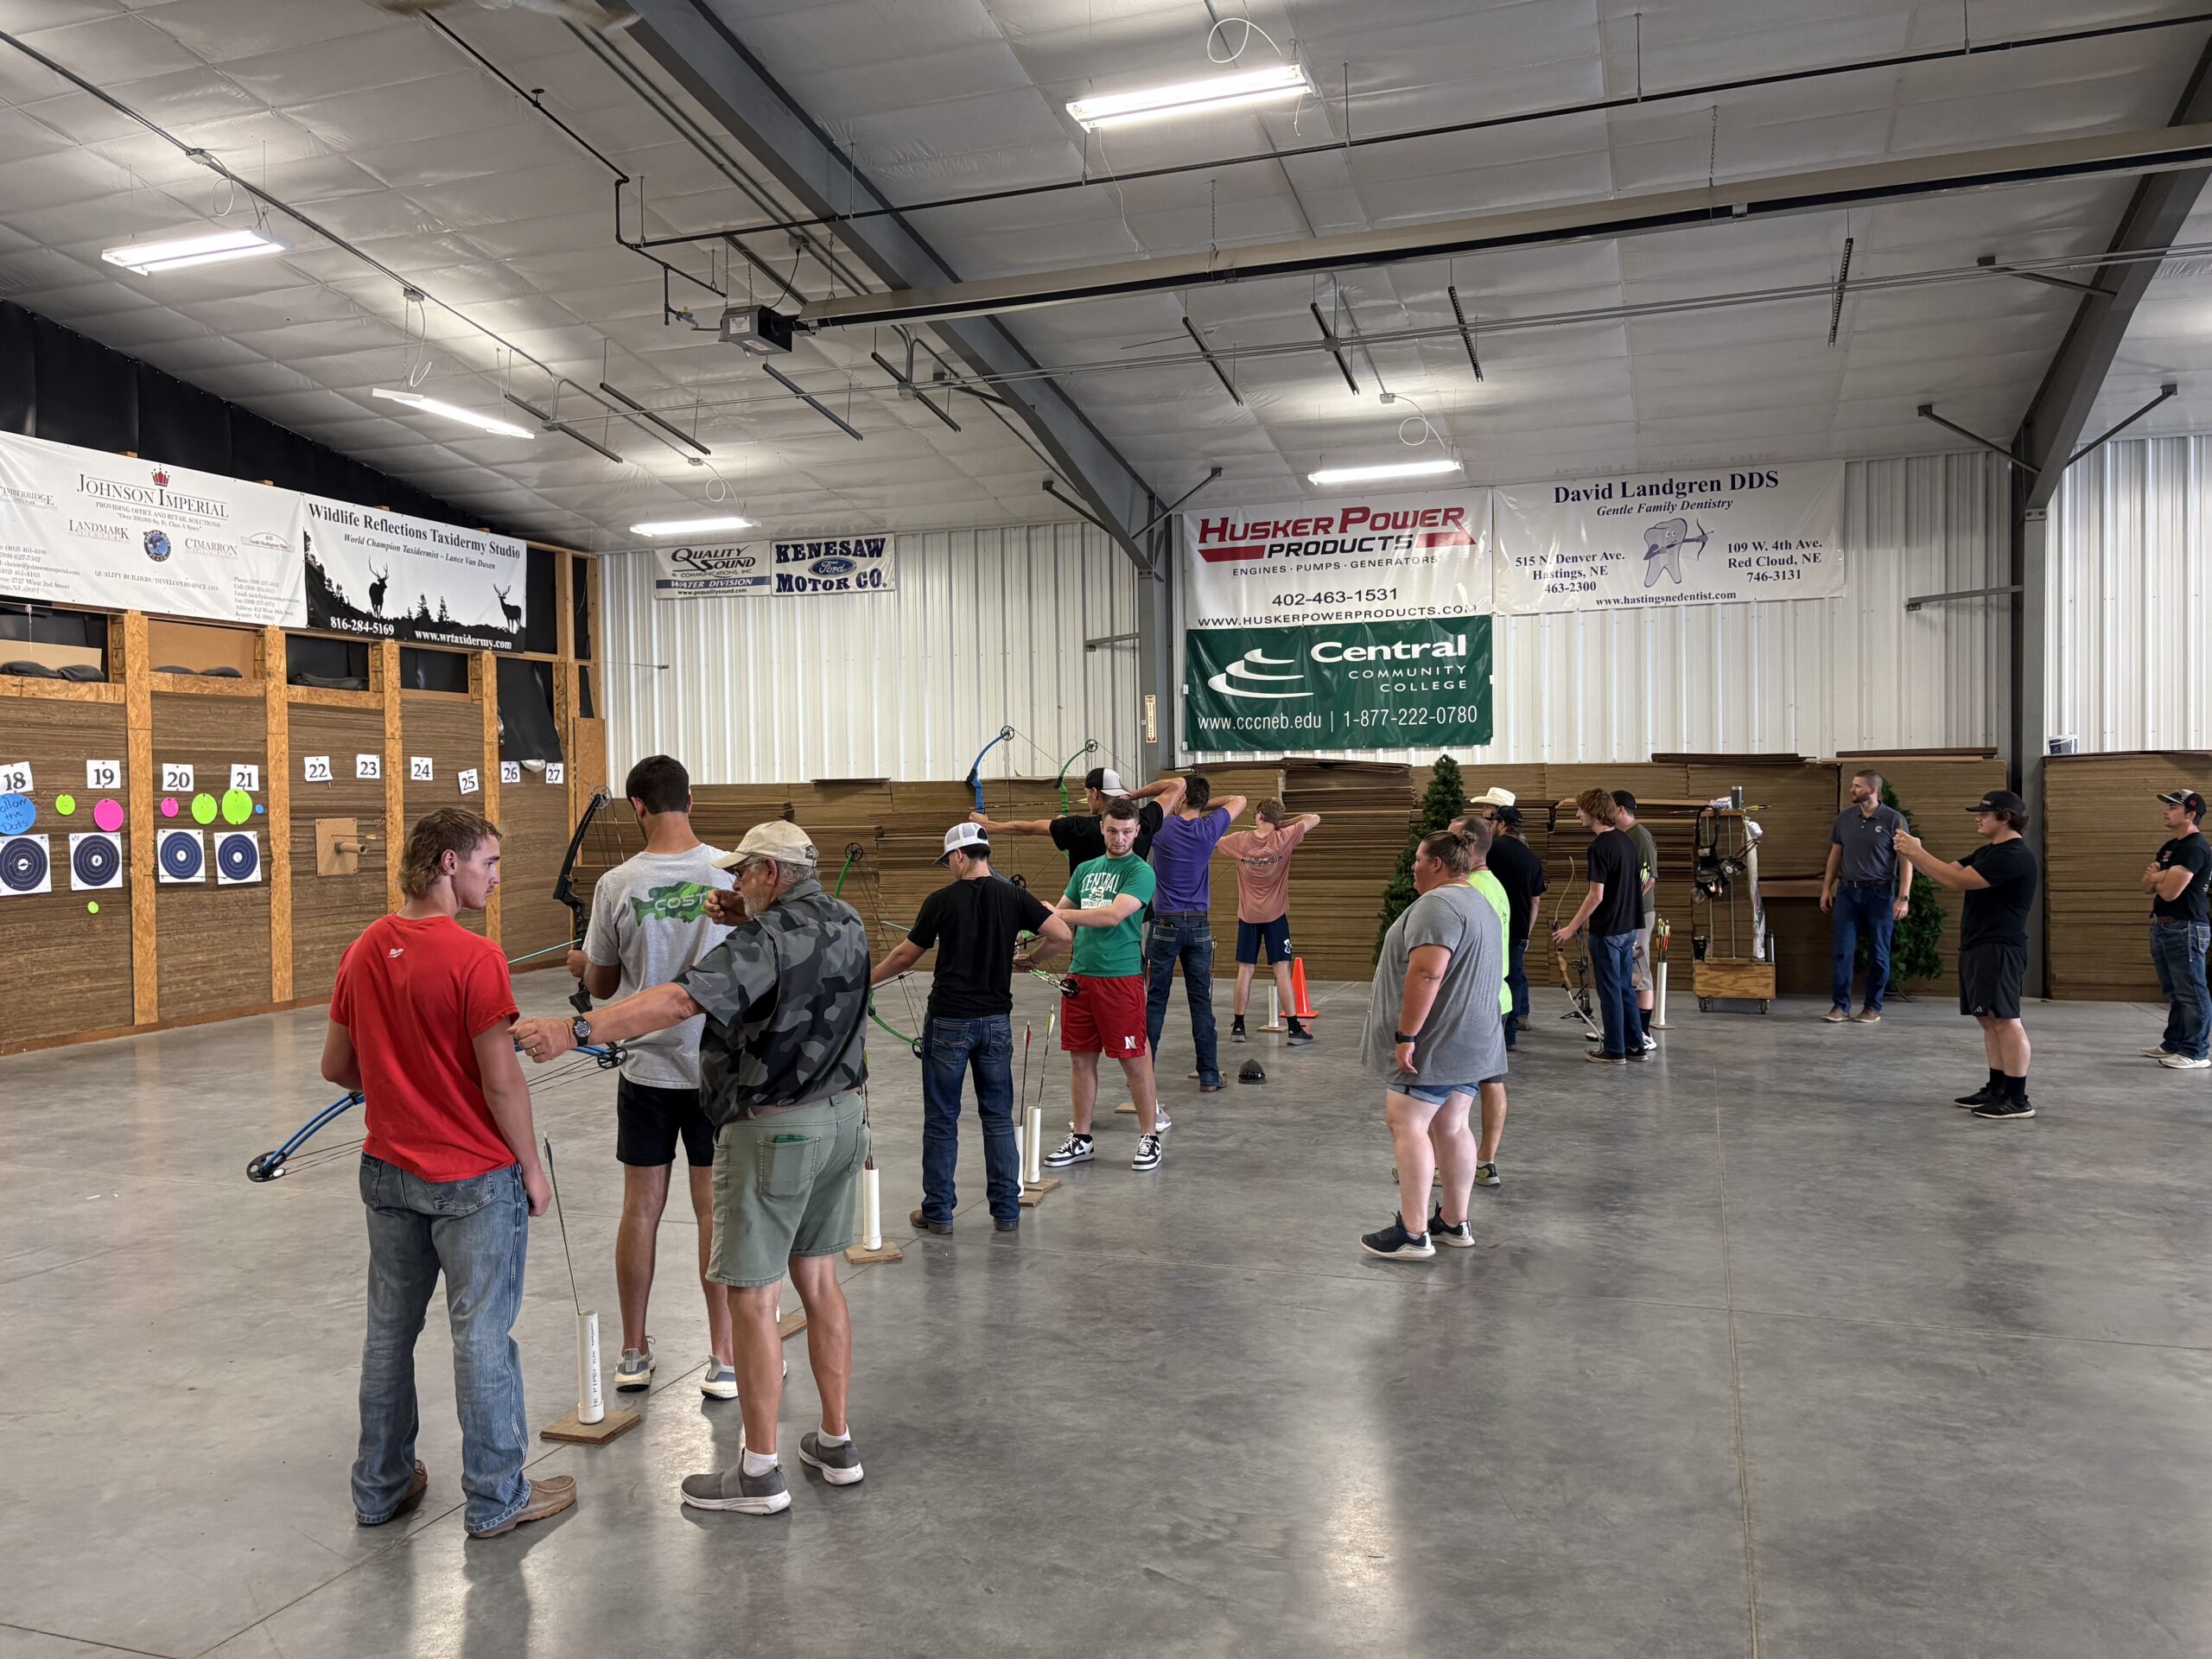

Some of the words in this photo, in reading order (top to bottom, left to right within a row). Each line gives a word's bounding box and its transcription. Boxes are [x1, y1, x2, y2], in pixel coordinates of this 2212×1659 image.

[77, 474, 155, 505] JOHNSON
[159, 489, 229, 518] IMPERIAL
[1554, 483, 1613, 504] David
[1620, 477, 1721, 501] Landgren
[1729, 470, 1779, 491] DDS
[96, 501, 130, 512] PROVIDING
[131, 507, 152, 517] OFFICE
[153, 511, 166, 519] AND
[188, 518, 221, 528] SOLUTIONS
[1597, 504, 1634, 517] Gentle
[1637, 501, 1678, 516] Family
[1680, 498, 1733, 512] Dentistry
[69, 519, 129, 540] LANDMARK
[308, 503, 359, 527] Wildlife
[364, 515, 428, 541] Reflections
[430, 529, 486, 555] Taxidermy
[489, 542, 520, 559] Studio
[1198, 517, 1334, 543] HUSKER
[1338, 506, 1465, 534] POWER
[185, 537, 237, 556] CIMARRON
[344, 533, 365, 546] World
[366, 537, 401, 553] Champion
[403, 544, 439, 559] Taxidermist
[445, 553, 464, 563] Lance
[465, 556, 476, 566] Van
[477, 559, 495, 569] Dusen
[671, 544, 752, 563] QUALITY
[775, 537, 887, 564] KENESAW
[1268, 534, 1414, 558] PRODUCTS
[1728, 542, 1749, 554] 109
[1751, 541, 1768, 552] W.
[1771, 538, 1793, 551] 4th
[1795, 537, 1822, 550] Ave.
[701, 557, 756, 570] SOUND
[818, 561, 845, 574] Ford
[1233, 565, 1287, 576] ENGINES
[1296, 562, 1340, 572] PUMPS
[1351, 556, 1439, 569] GENERATORS
[1515, 556, 1536, 568] 515
[1539, 555, 1553, 566] N.
[1555, 552, 1598, 564] Denver
[1599, 550, 1625, 563] Ave.
[1727, 556, 1753, 568] Red
[1755, 554, 1798, 569] Cloud,
[1801, 552, 1821, 564] NE
[776, 575, 850, 594] MOTOR
[855, 568, 887, 588] CO.
[1532, 567, 1586, 582] Hastings,
[1589, 565, 1608, 576] NE
[1746, 569, 1802, 583] 746-3131
[671, 580, 705, 588] WATER
[709, 578, 753, 588] DIVISION
[1544, 581, 1597, 594] 463-2300
[1272, 588, 1398, 607] 402-463-1531
[1596, 590, 1737, 607] www.hastingsnedentist.com
[1198, 604, 1477, 627] WWW.HUSKERPOWERPRODUCTS.COM
[330, 616, 395, 636] 816-284-5169
[415, 631, 512, 650] www.wrtaxidermy.com
[1311, 634, 1466, 663] Central
[1349, 665, 1467, 679] COMMUNITY
[1380, 680, 1467, 693] COLLEGE
[1198, 712, 1321, 730] www.cccneb.edu
[1344, 705, 1478, 728] 1-877-222-0780
[93, 768, 114, 785] 19
[308, 763, 327, 778] 22
[359, 761, 377, 775] 23
[414, 763, 430, 778] 24
[504, 767, 518, 780] 26
[547, 768, 560, 781] 27
[3, 772, 26, 791] 18
[167, 772, 190, 788] 20
[236, 772, 253, 788] 21
[461, 775, 475, 791] 25
[4, 810, 22, 821] the
[2, 819, 29, 832] Dots
[1079, 872, 1120, 894] CENTRAL
[654, 893, 708, 911] COST
[1125, 1035, 1137, 1049] N
